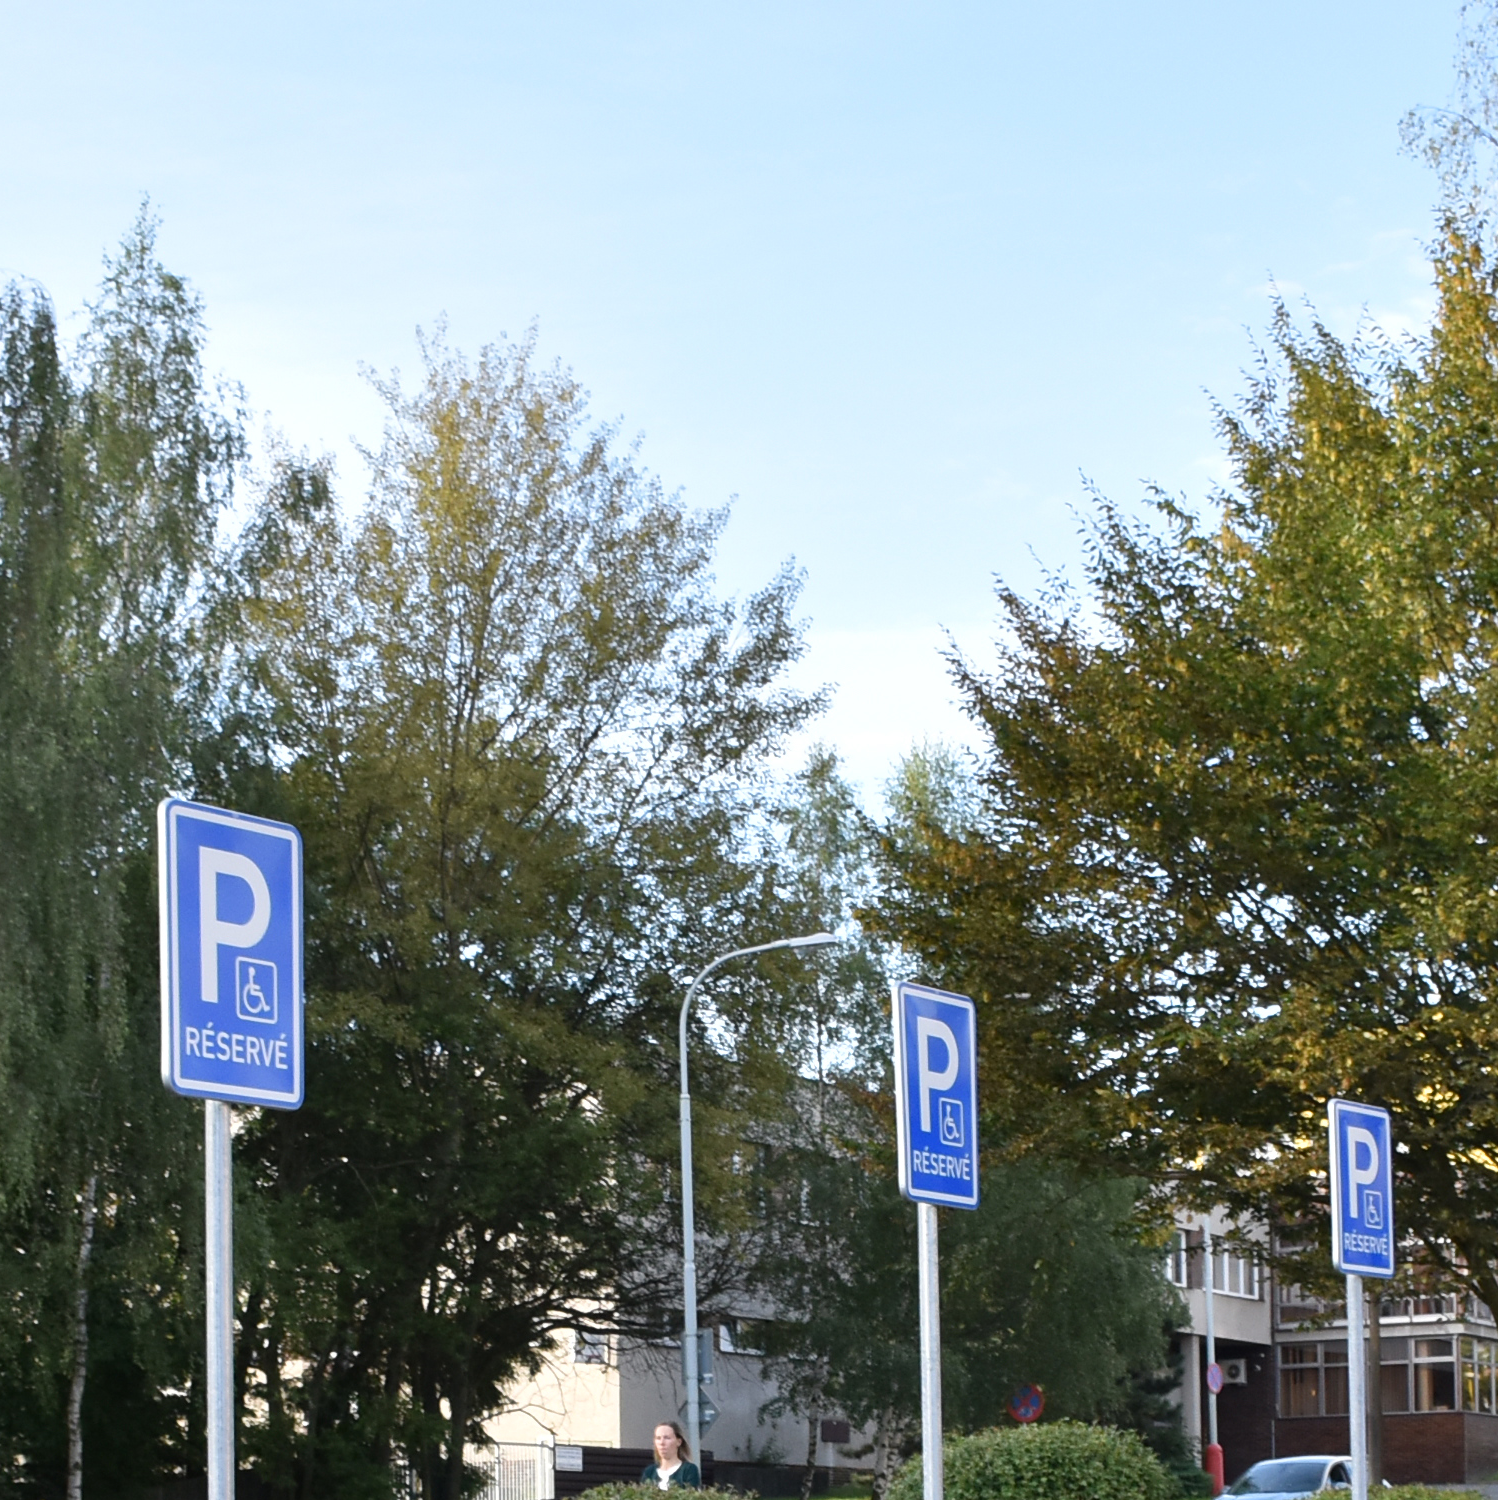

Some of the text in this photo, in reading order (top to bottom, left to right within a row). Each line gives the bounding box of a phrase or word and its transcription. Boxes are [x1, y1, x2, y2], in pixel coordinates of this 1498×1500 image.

[198, 845, 272, 1004] P
[185, 1021, 289, 1070] RÉSERVÉ
[917, 1015, 960, 1133] P
[913, 1145, 971, 1181] RÉSERVÉ
[1347, 1125, 1379, 1219] P
[1344, 1229, 1388, 1256] RÉSERVÉ
